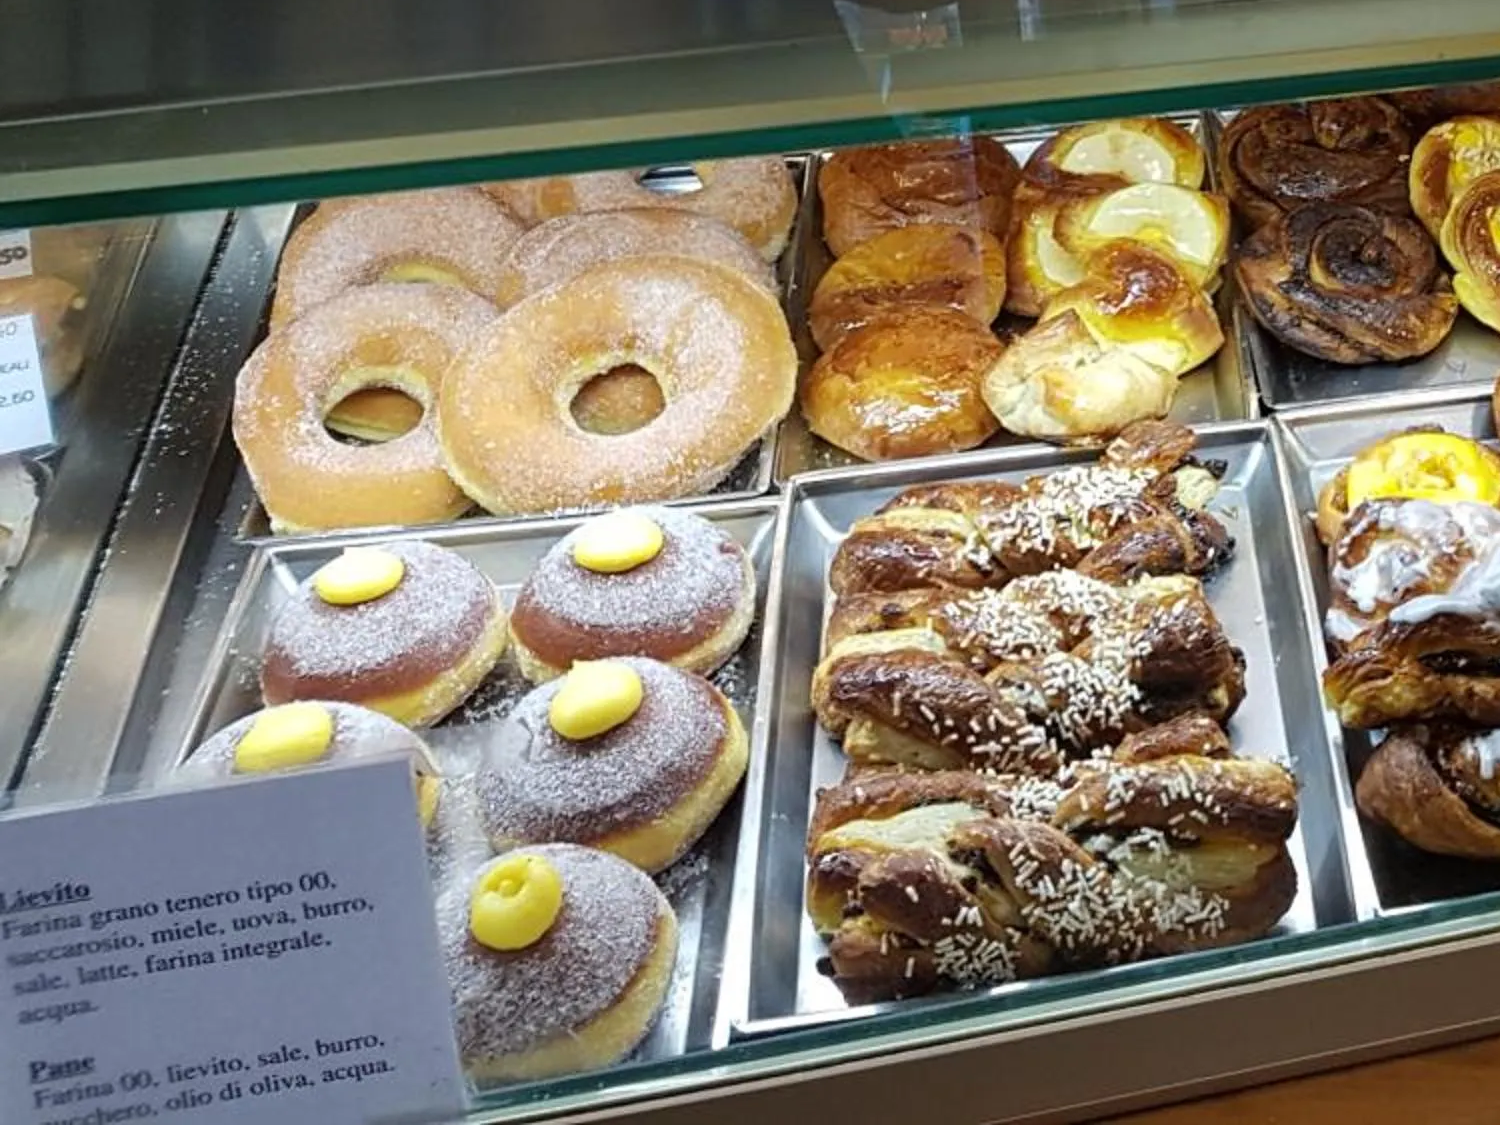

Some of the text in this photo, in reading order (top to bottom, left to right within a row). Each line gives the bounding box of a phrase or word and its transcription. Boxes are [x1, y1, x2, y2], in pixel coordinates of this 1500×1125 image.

[0, 882, 91, 913] Lievito
[2, 914, 82, 940] Farina
[90, 902, 159, 931] grano
[165, 890, 240, 914] tenero
[247, 881, 293, 903] tipo
[145, 949, 215, 973] farina
[30, 1056, 95, 1084] Pane
[34, 1082, 115, 1109] Farina
[165, 1088, 213, 1111] olio
[219, 1081, 243, 1101] di
